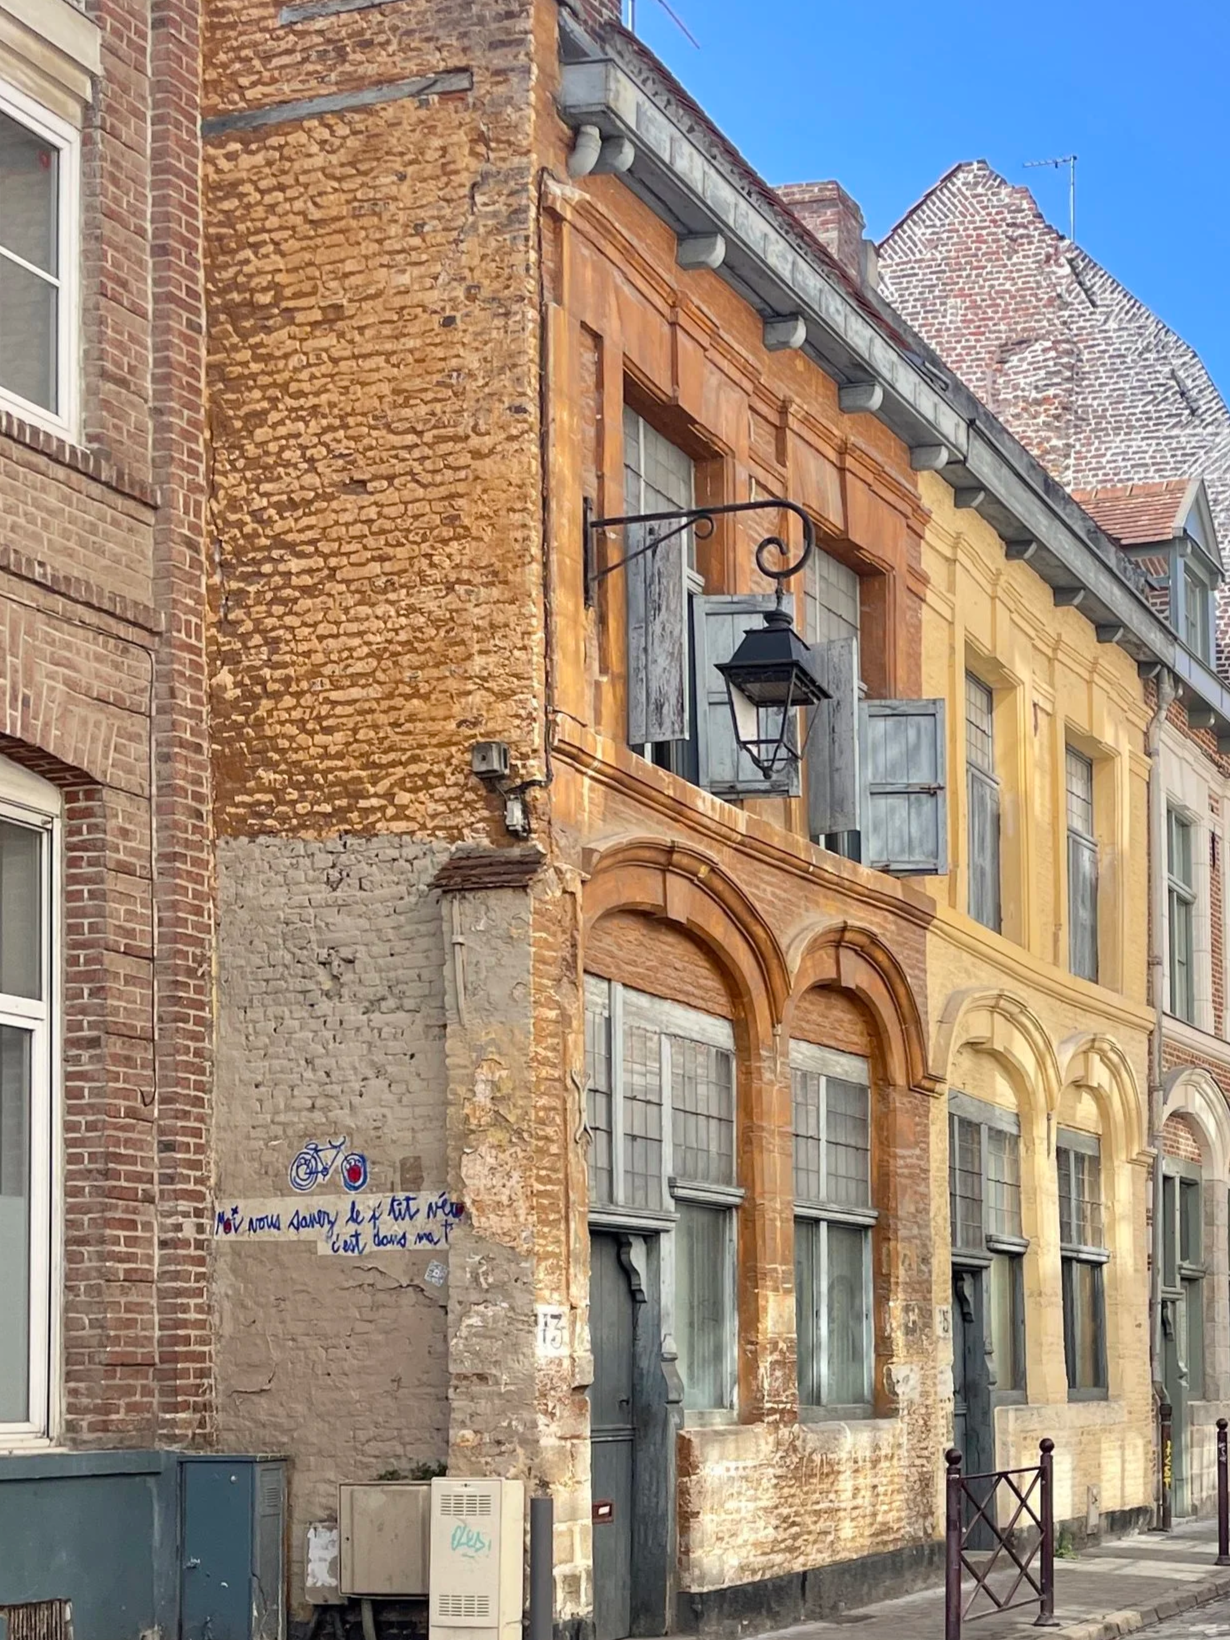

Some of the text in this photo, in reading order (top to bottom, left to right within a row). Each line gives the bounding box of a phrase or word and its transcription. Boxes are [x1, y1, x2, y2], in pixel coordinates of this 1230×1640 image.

[247, 1213, 281, 1237] vous
[345, 1200, 365, 1226] le
[331, 1228, 368, 1255] c'est
[373, 1227, 407, 1248] dans
[414, 1230, 441, 1246] ma
[542, 1312, 566, 1350] 13
